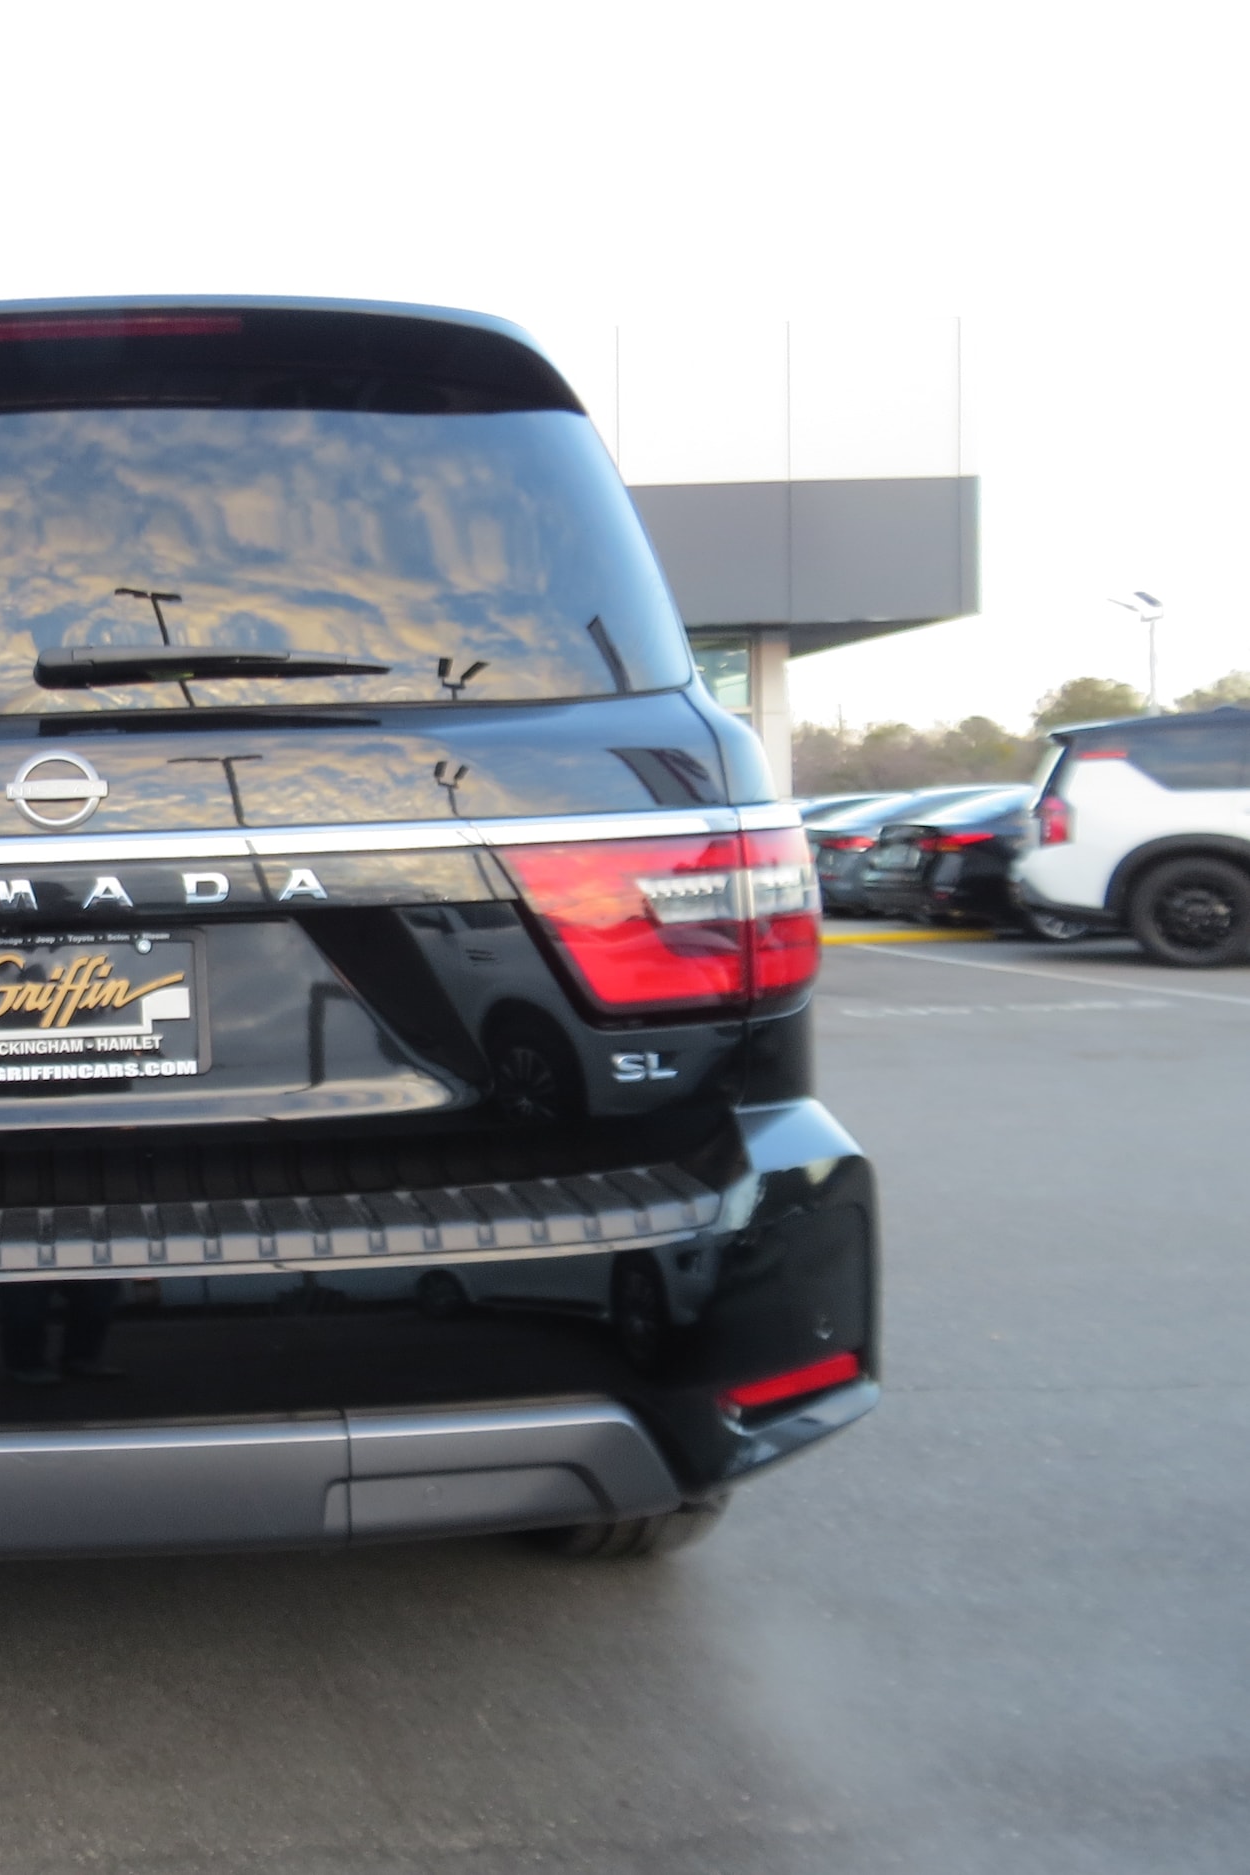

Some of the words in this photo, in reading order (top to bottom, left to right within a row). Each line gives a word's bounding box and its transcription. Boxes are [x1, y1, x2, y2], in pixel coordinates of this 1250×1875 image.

[67, 934, 95, 944] Toyota
[97, 1035, 163, 1050] HAMLET
[611, 1051, 679, 1082] SL
